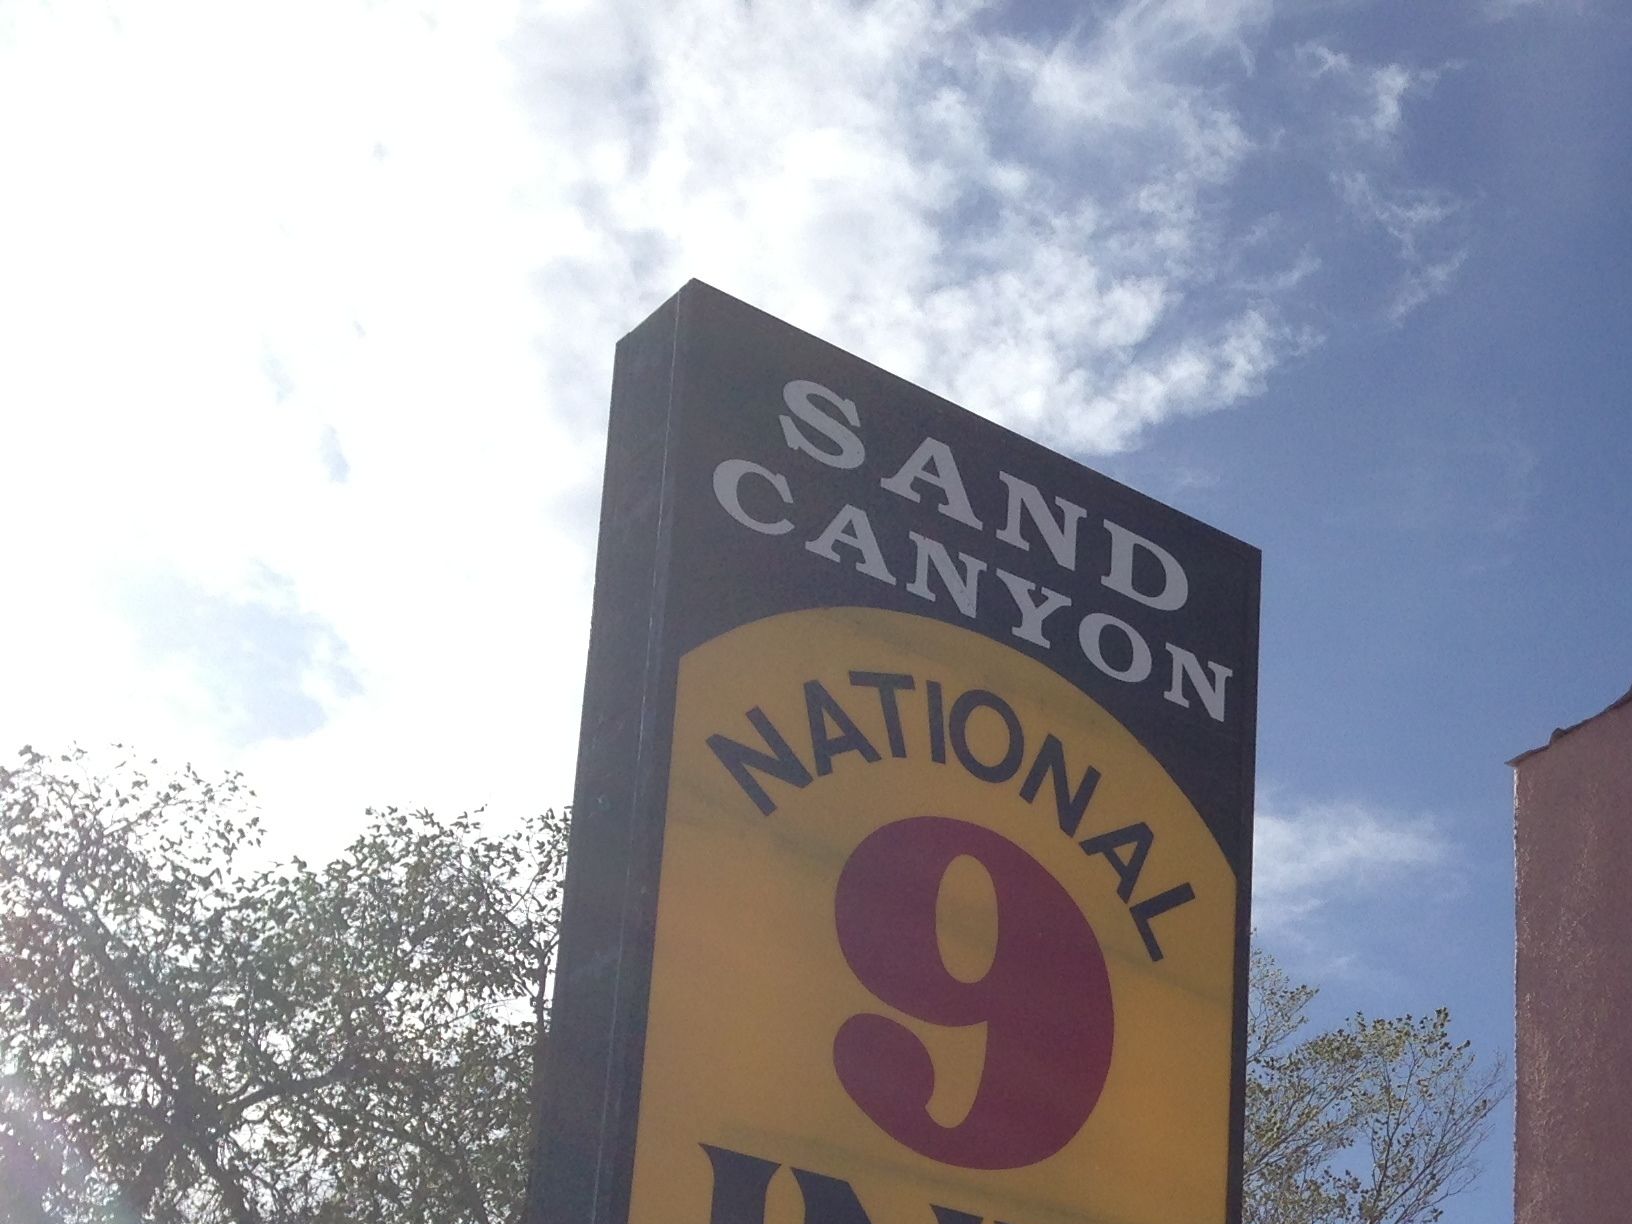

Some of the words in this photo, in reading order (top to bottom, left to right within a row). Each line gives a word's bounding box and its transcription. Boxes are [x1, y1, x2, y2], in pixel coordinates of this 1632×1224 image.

[712, 458, 1233, 722] CANYON
[779, 379, 1189, 612] SAND
[705, 670, 1195, 962] NATIONAL
[833, 815, 1115, 1170] 9
